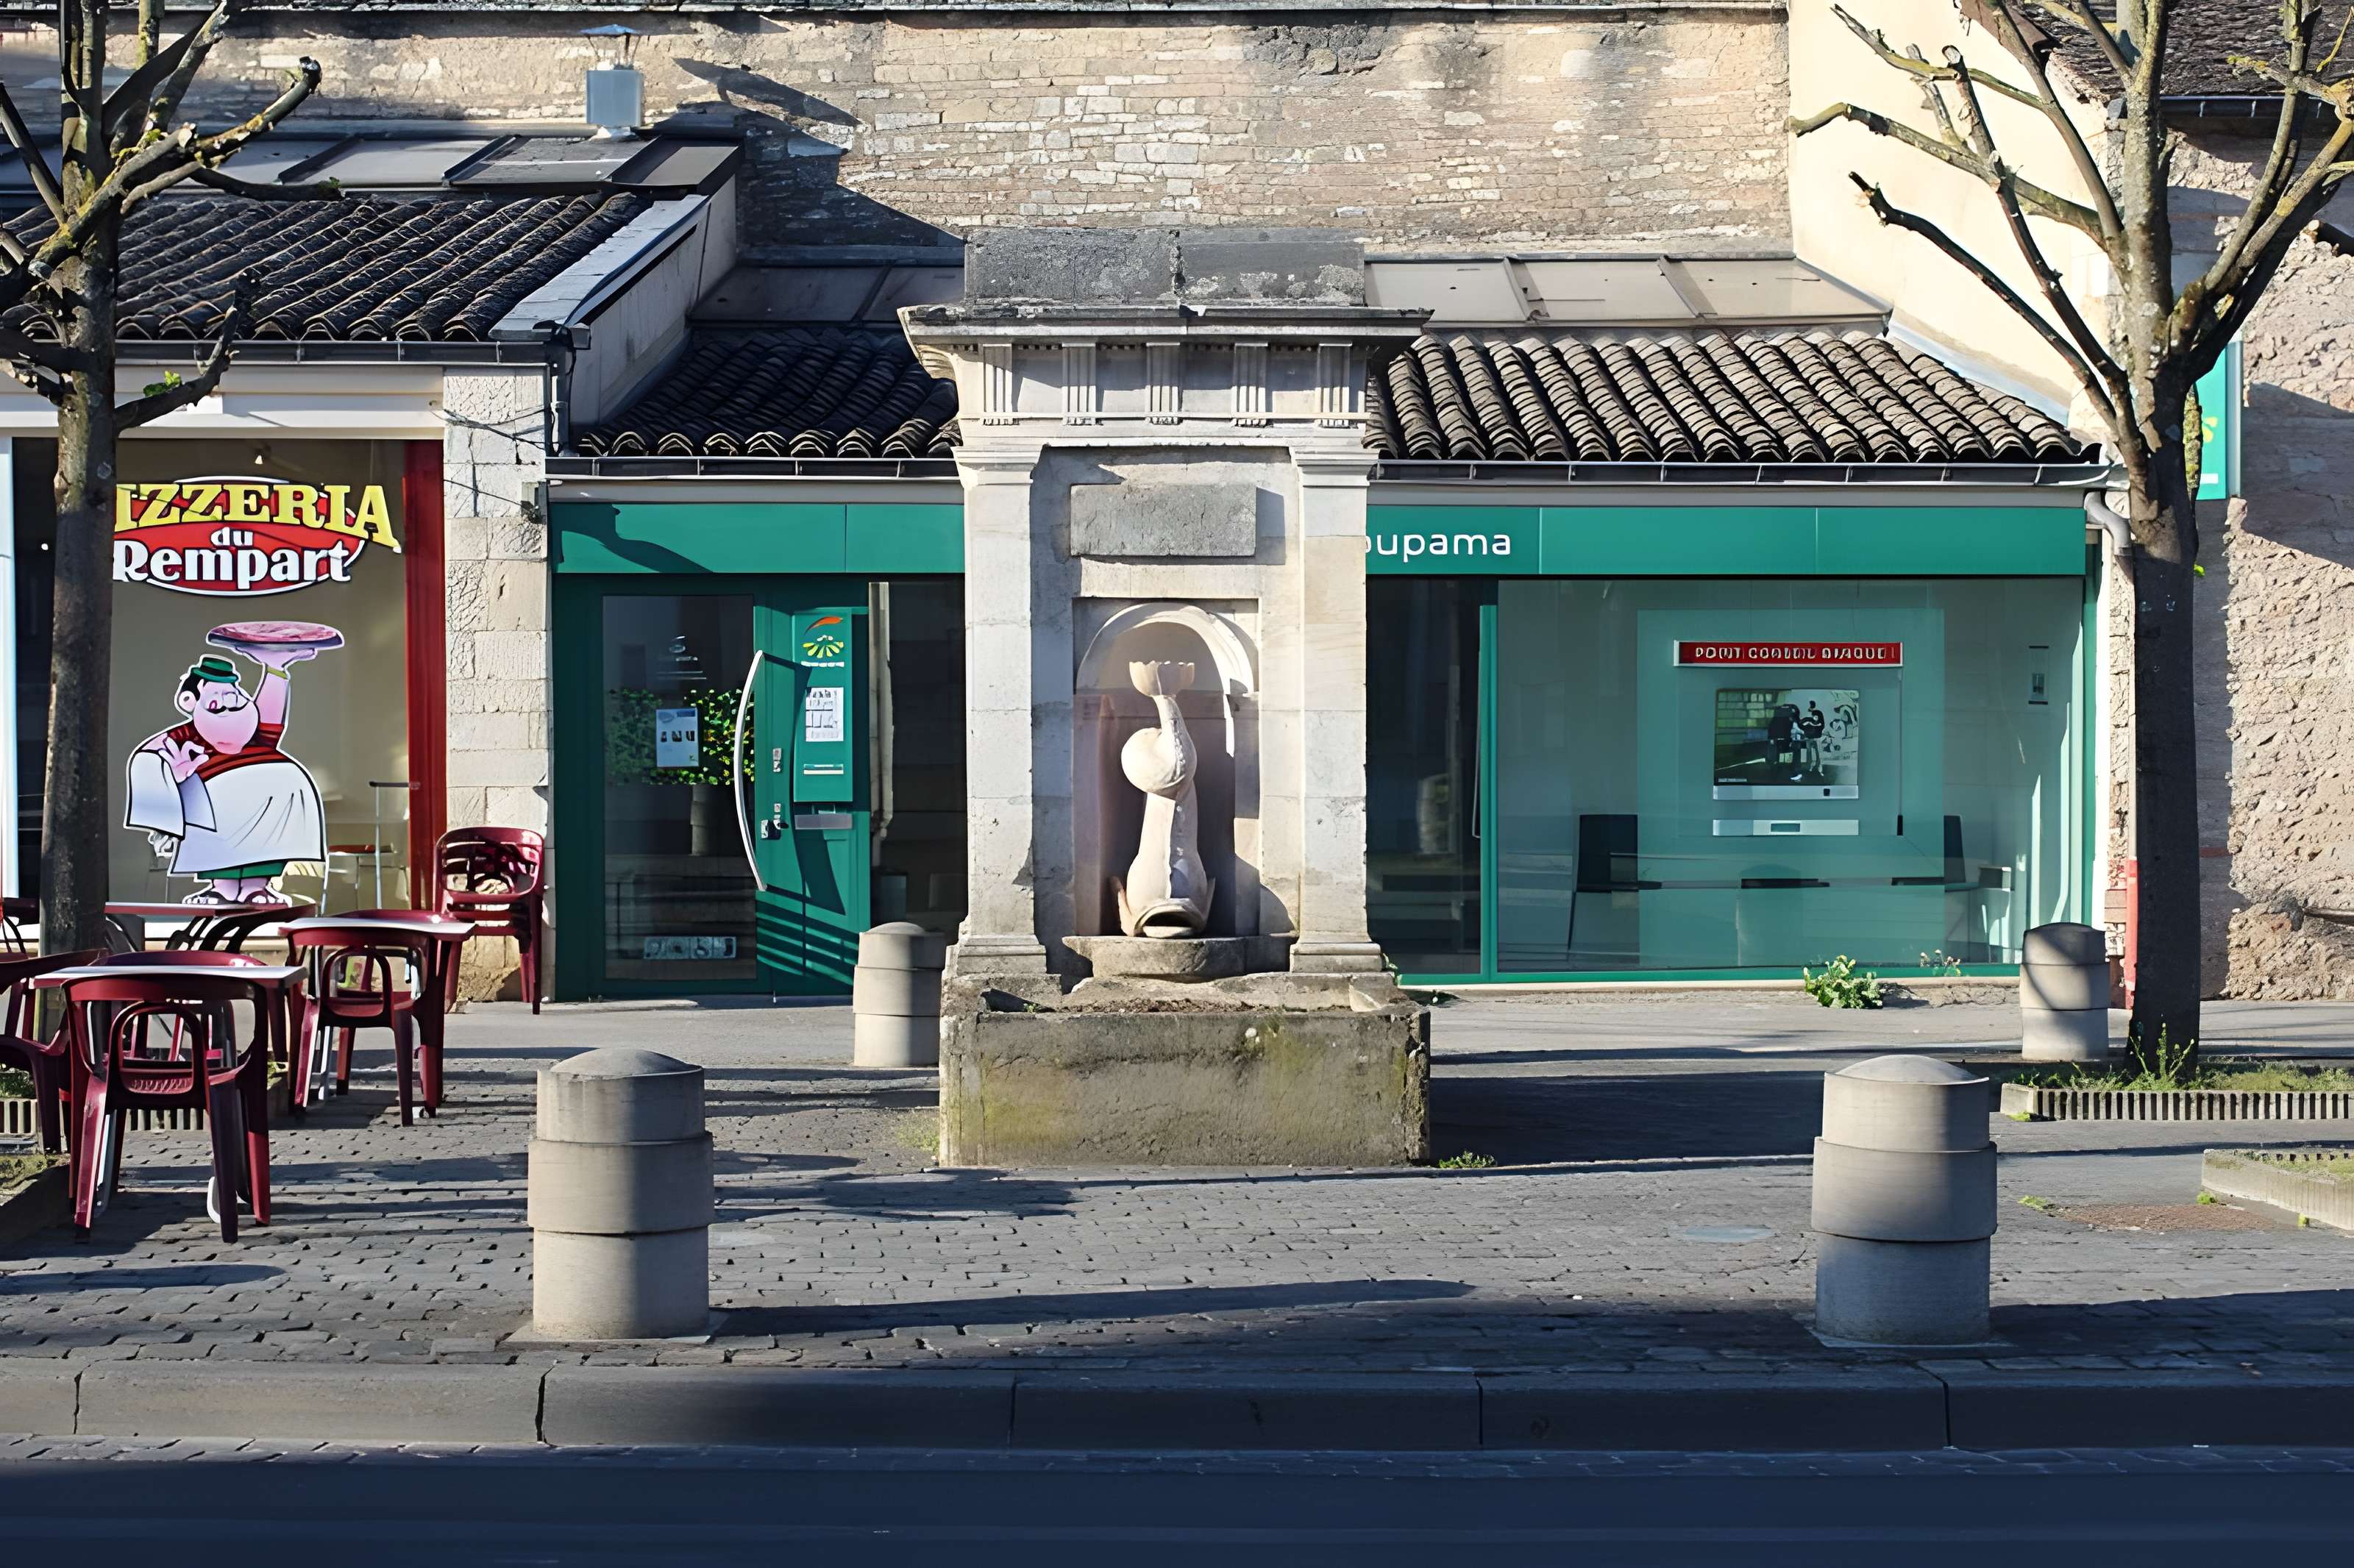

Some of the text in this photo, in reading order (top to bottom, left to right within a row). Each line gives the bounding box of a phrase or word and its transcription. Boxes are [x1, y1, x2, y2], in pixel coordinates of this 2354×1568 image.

[115, 483, 402, 553] IZZERIA
[210, 527, 253, 546] du
[113, 539, 351, 590] Rempart
[1366, 534, 1511, 563] upama
